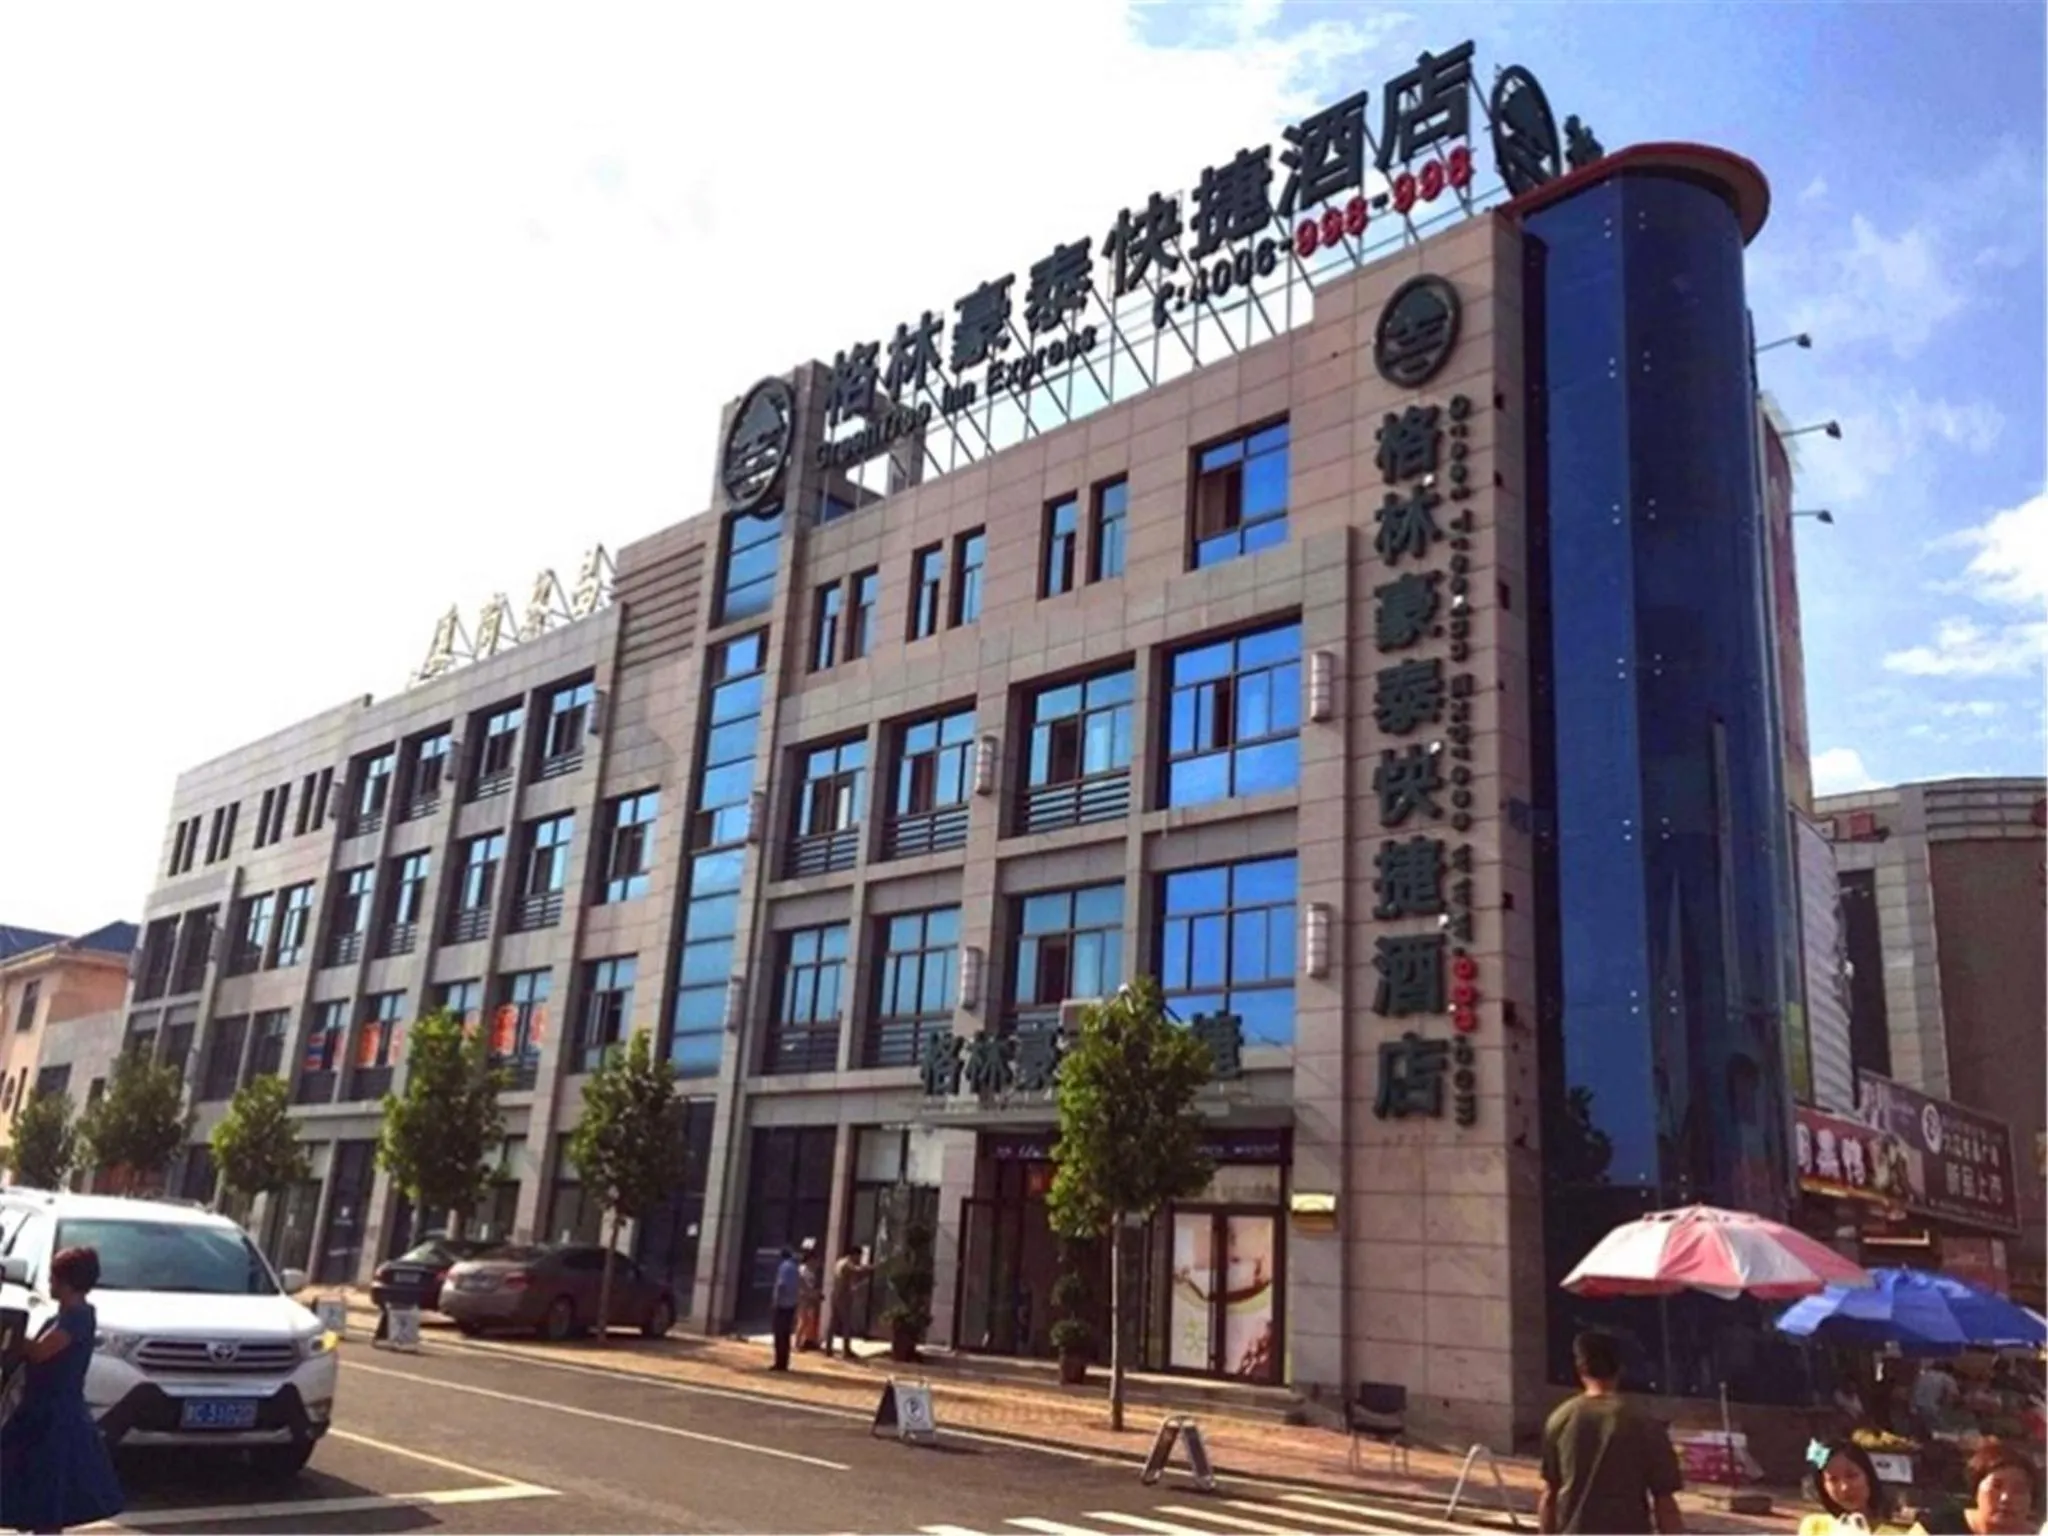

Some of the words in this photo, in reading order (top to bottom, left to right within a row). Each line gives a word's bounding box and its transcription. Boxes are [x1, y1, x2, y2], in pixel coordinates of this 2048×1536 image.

[824, 39, 1476, 429] 格林豪泰快捷酒店
[986, 323, 1098, 397] Express
[1373, 404, 1449, 1123] 格林豪泰快捷酒店
